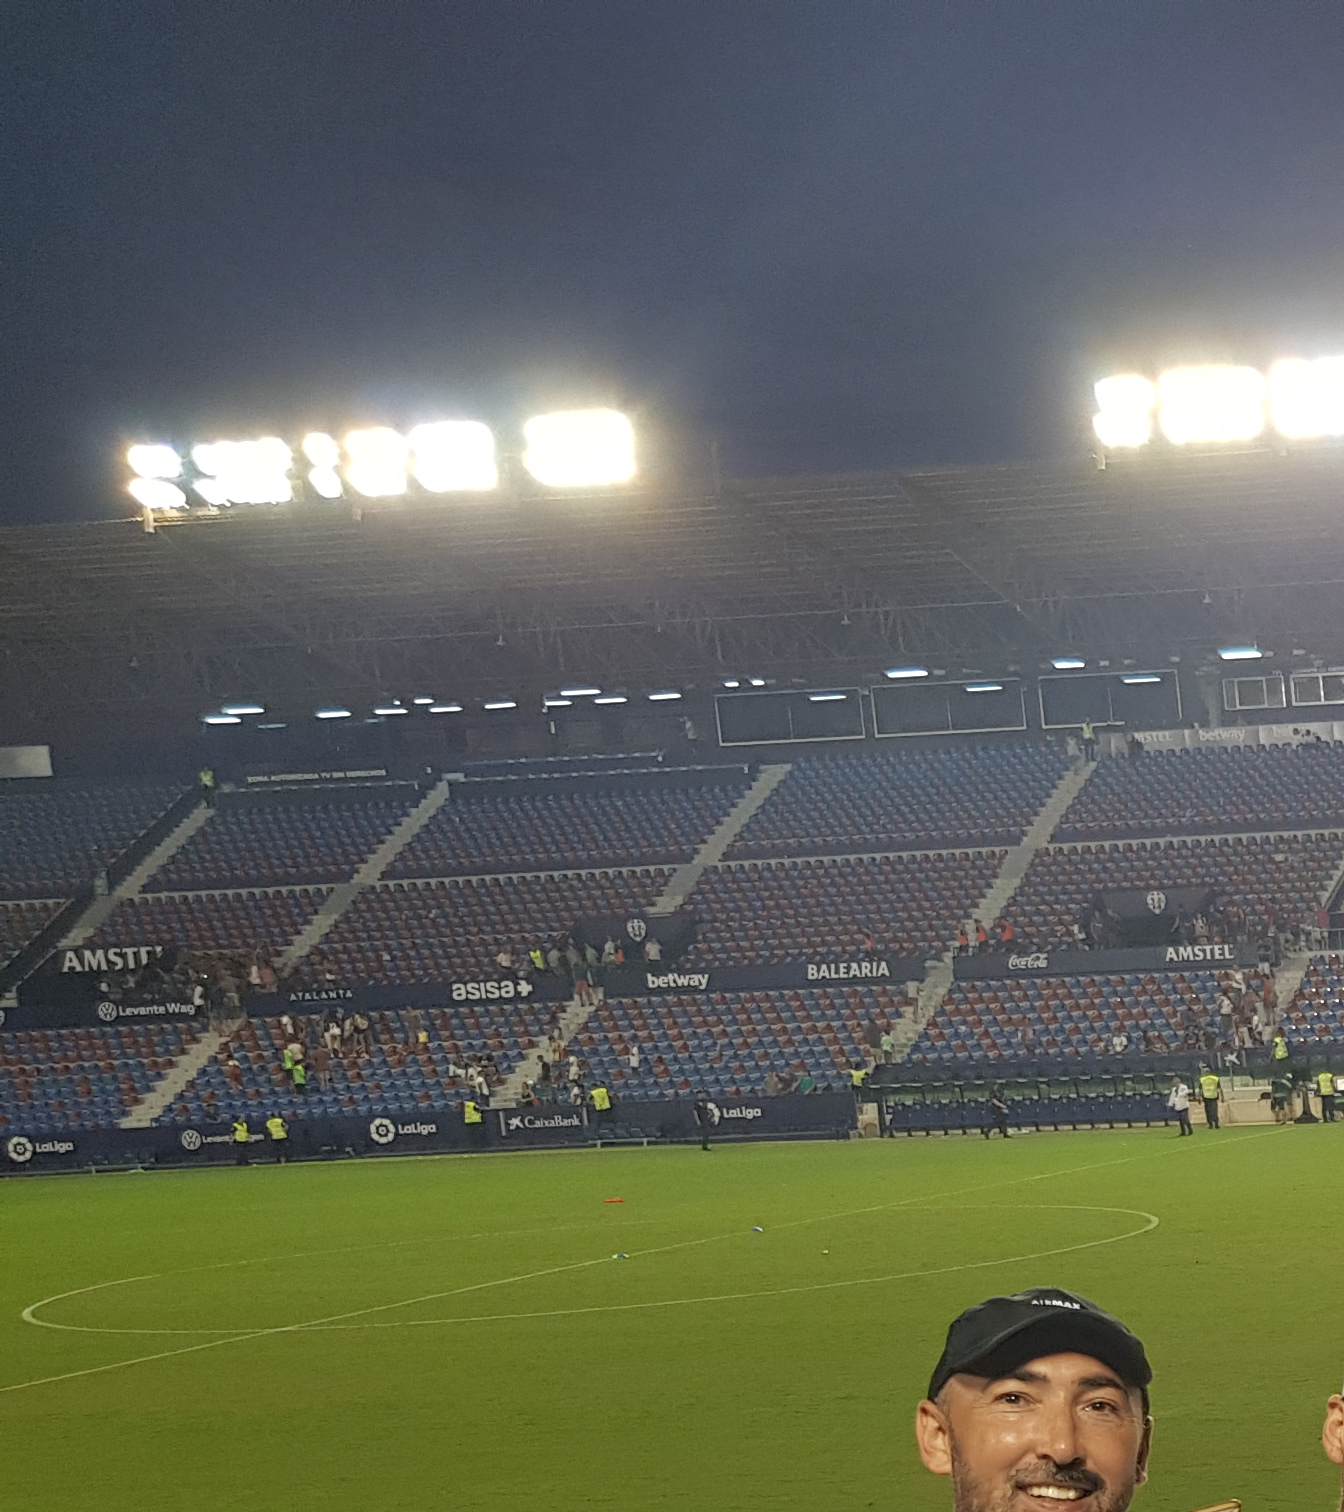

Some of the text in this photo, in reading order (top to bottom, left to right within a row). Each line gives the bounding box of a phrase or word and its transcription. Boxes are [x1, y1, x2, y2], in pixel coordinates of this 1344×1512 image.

[62, 946, 164, 973] AMST
[1165, 944, 1235, 962] AMSTEL
[647, 972, 710, 990] betway
[289, 989, 353, 1001] ATALANTA
[118, 1002, 196, 1016] Levante Wag
[723, 1106, 762, 1119] LaLiga
[398, 1122, 437, 1136] LaLiga
[524, 1114, 581, 1129] CaixaBank
[36, 1140, 74, 1155] LaLiga
